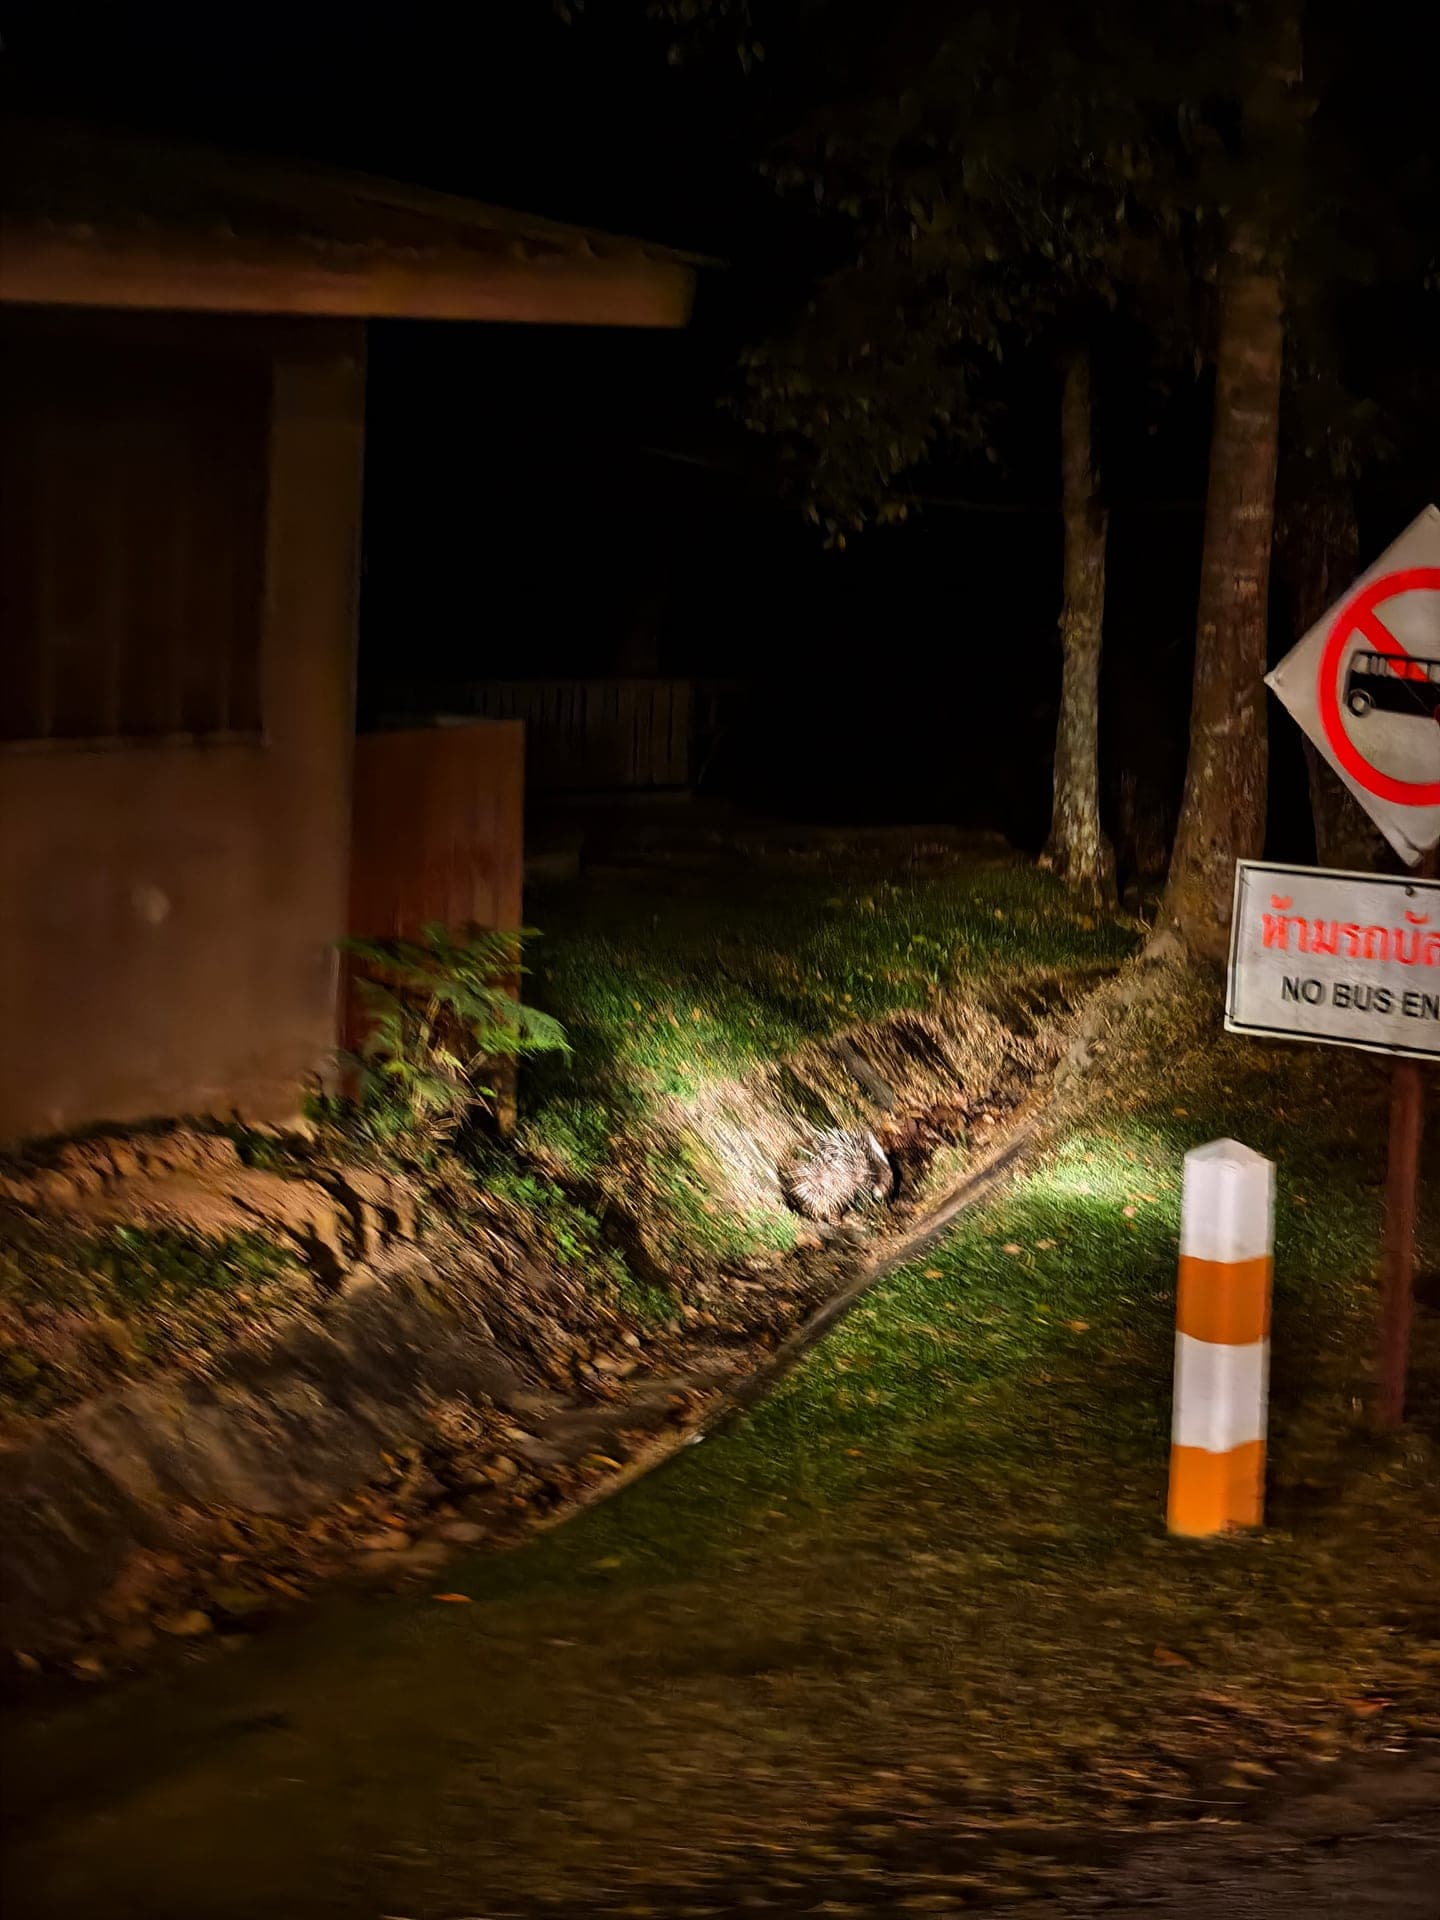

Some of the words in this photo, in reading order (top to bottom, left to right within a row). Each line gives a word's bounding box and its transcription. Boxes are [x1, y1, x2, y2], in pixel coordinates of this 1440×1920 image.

[1281, 976, 1325, 1005] NO
[1332, 982, 1395, 1014] BUS
[1402, 992, 1440, 1020] EN
